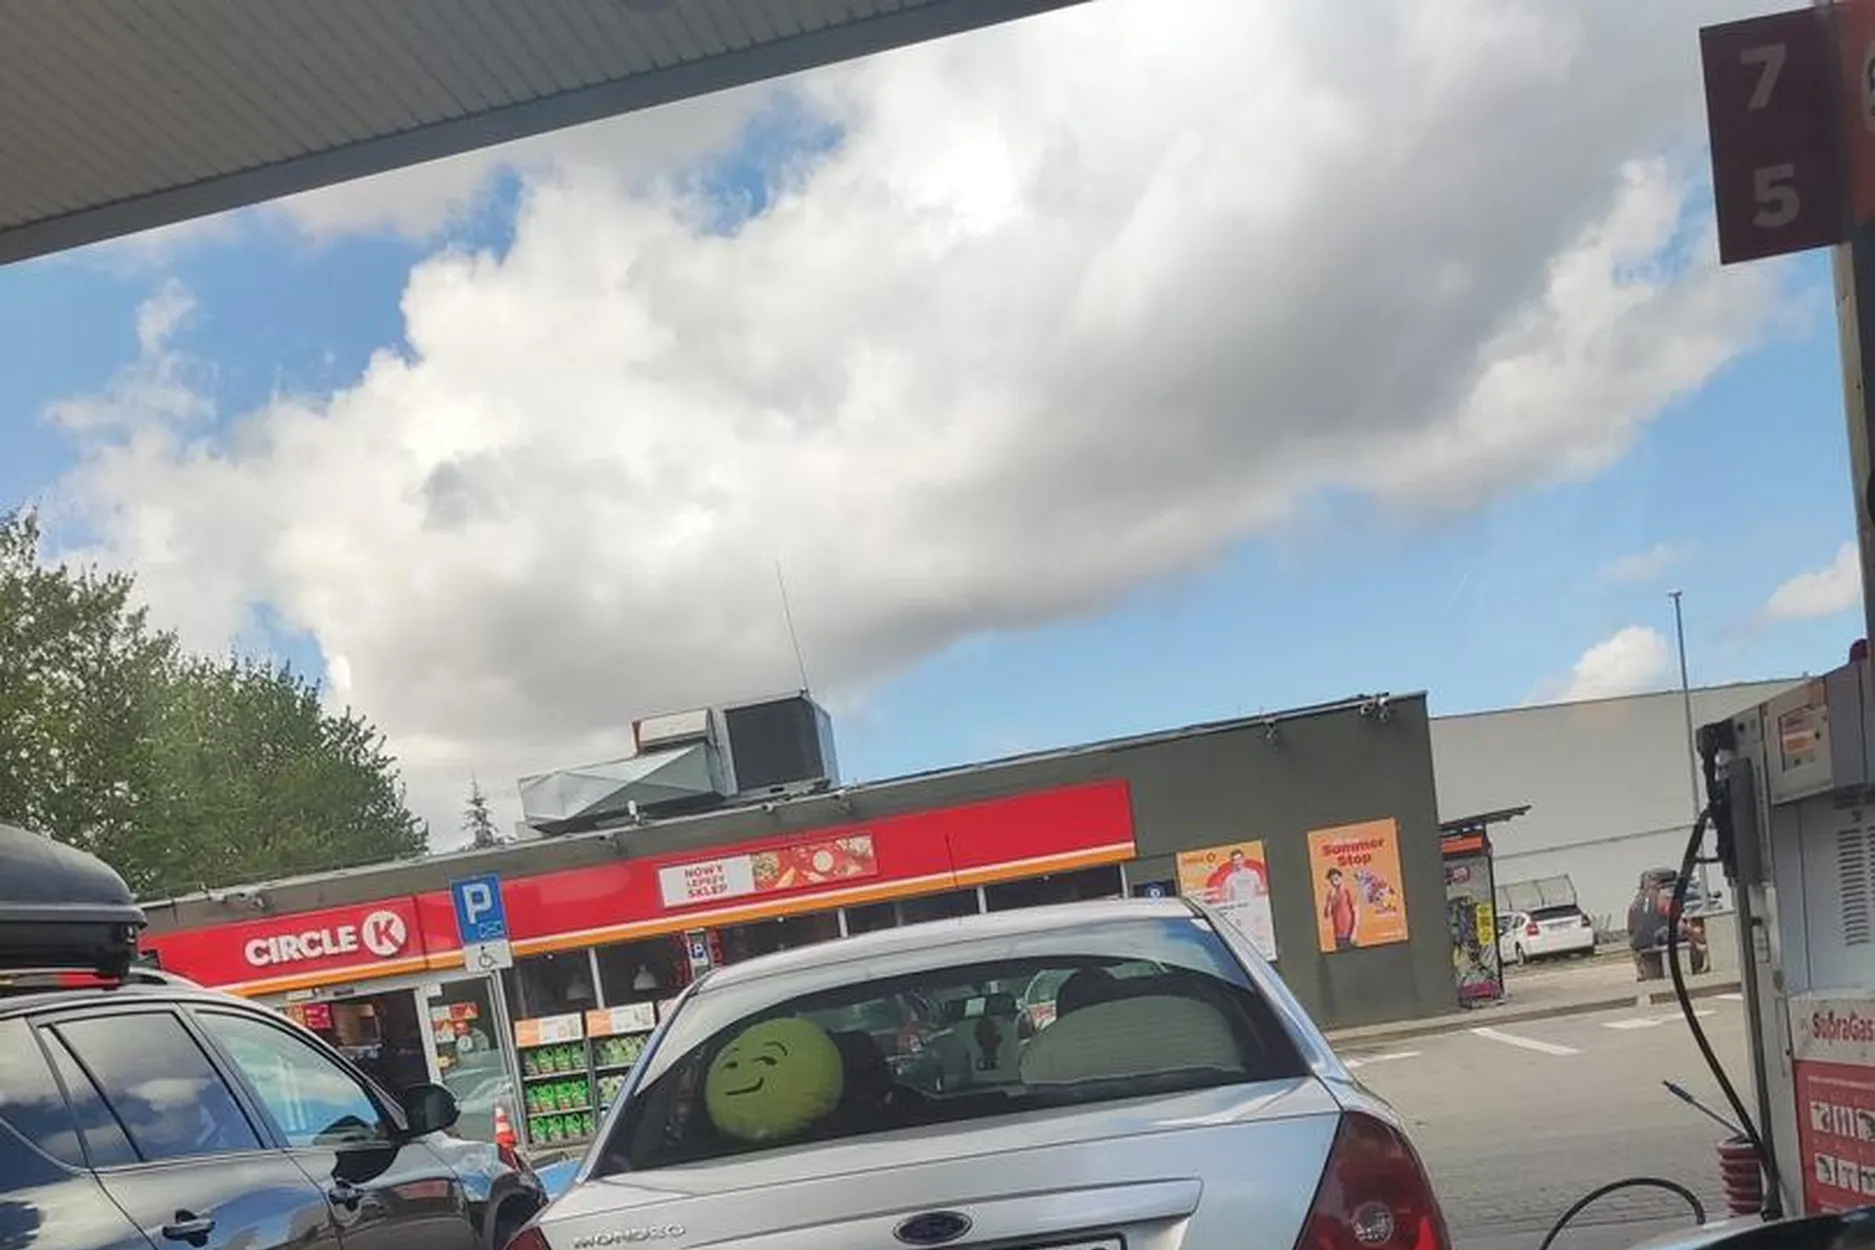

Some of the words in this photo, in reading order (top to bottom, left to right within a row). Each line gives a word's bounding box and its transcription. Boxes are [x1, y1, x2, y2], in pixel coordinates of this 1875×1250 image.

[1740, 43, 1788, 111] 7
[1752, 164, 1801, 229] 5
[1321, 838, 1385, 856] Summer
[1337, 854, 1372, 867] Stop
[684, 864, 724, 878] NOWY
[462, 883, 493, 925] P
[687, 883, 728, 897] SKLEP
[244, 925, 360, 967] CIRCLE
[369, 917, 402, 951] K
